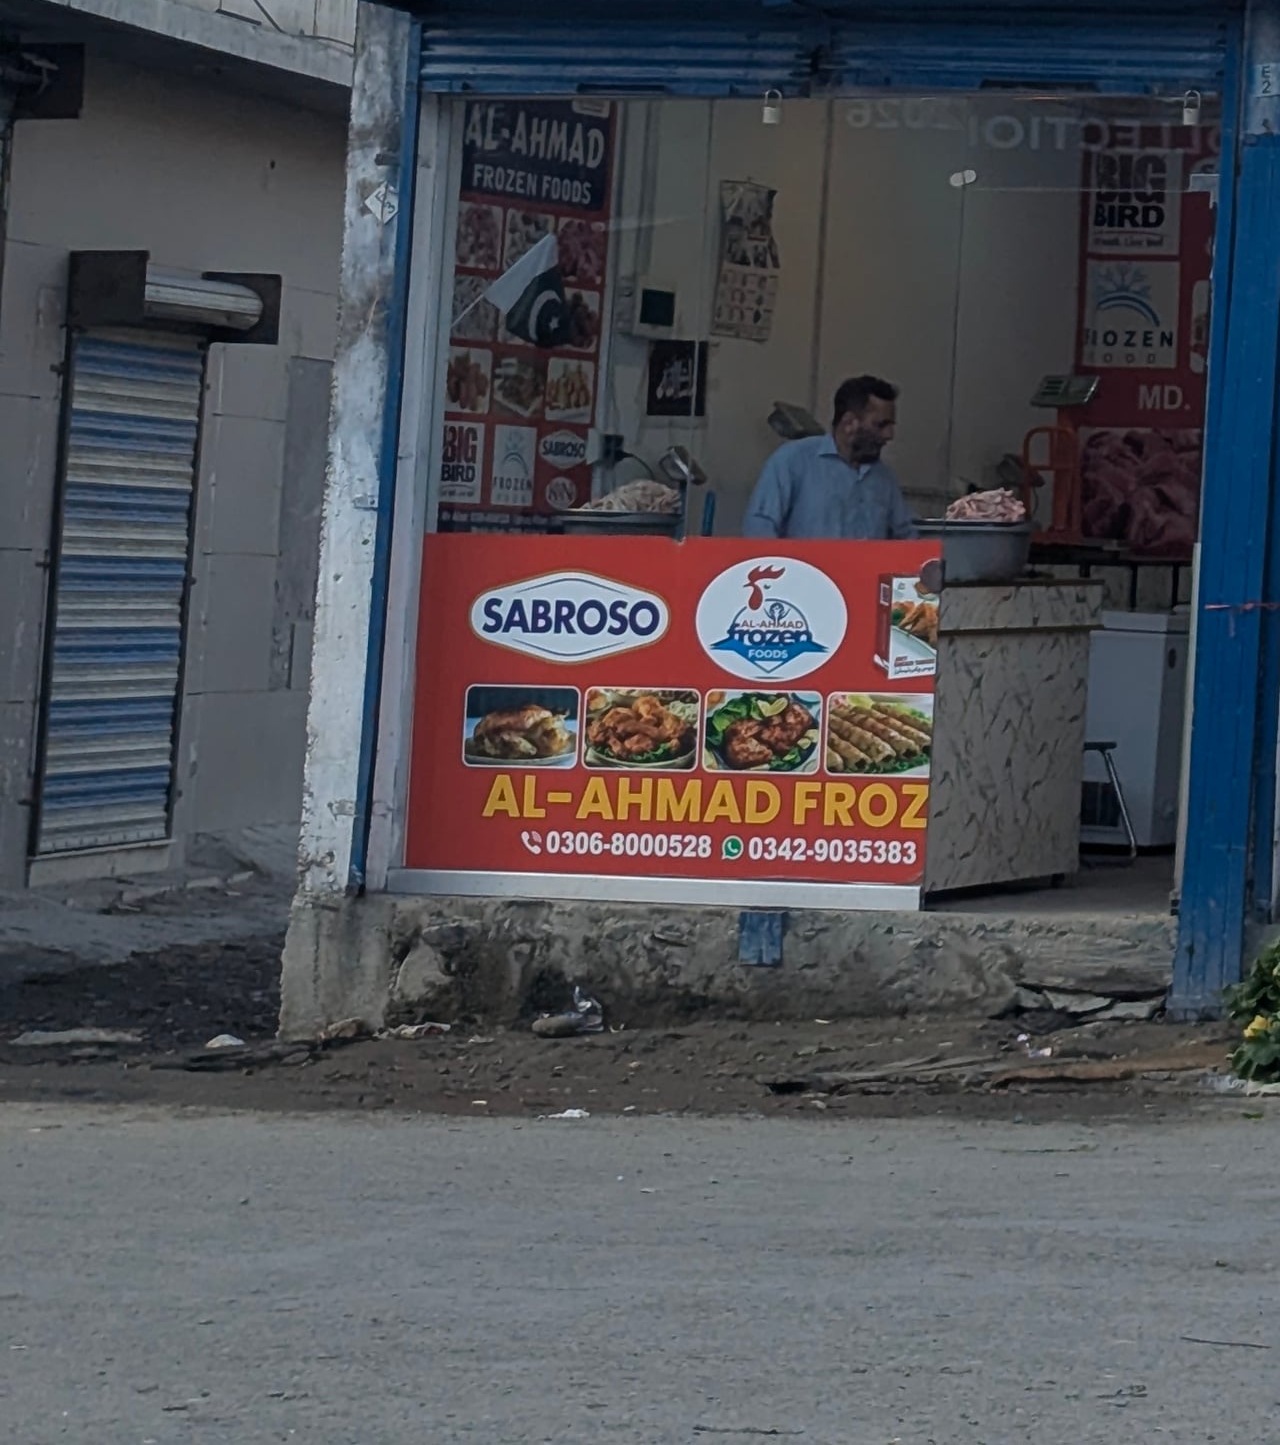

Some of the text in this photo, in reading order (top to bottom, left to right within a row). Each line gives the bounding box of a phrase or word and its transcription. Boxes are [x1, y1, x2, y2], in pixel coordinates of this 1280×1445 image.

[465, 103, 606, 169] AL-AHMAD
[472, 163, 592, 205] FROZEN FOODS
[1096, 154, 1167, 204] BIG
[1094, 204, 1165, 228] BIRD
[1137, 384, 1191, 411] MD.
[443, 424, 478, 464] BIG
[441, 464, 476, 483] BIRD
[482, 597, 660, 636] SABROSO
[741, 619, 804, 629] AL-AHMAD
[728, 623, 813, 645] frozen
[748, 649, 789, 660] FOODS
[482, 774, 928, 828] AL-AHMAD FROZ
[546, 831, 917, 865] 0306-8000528 0342-9035383
